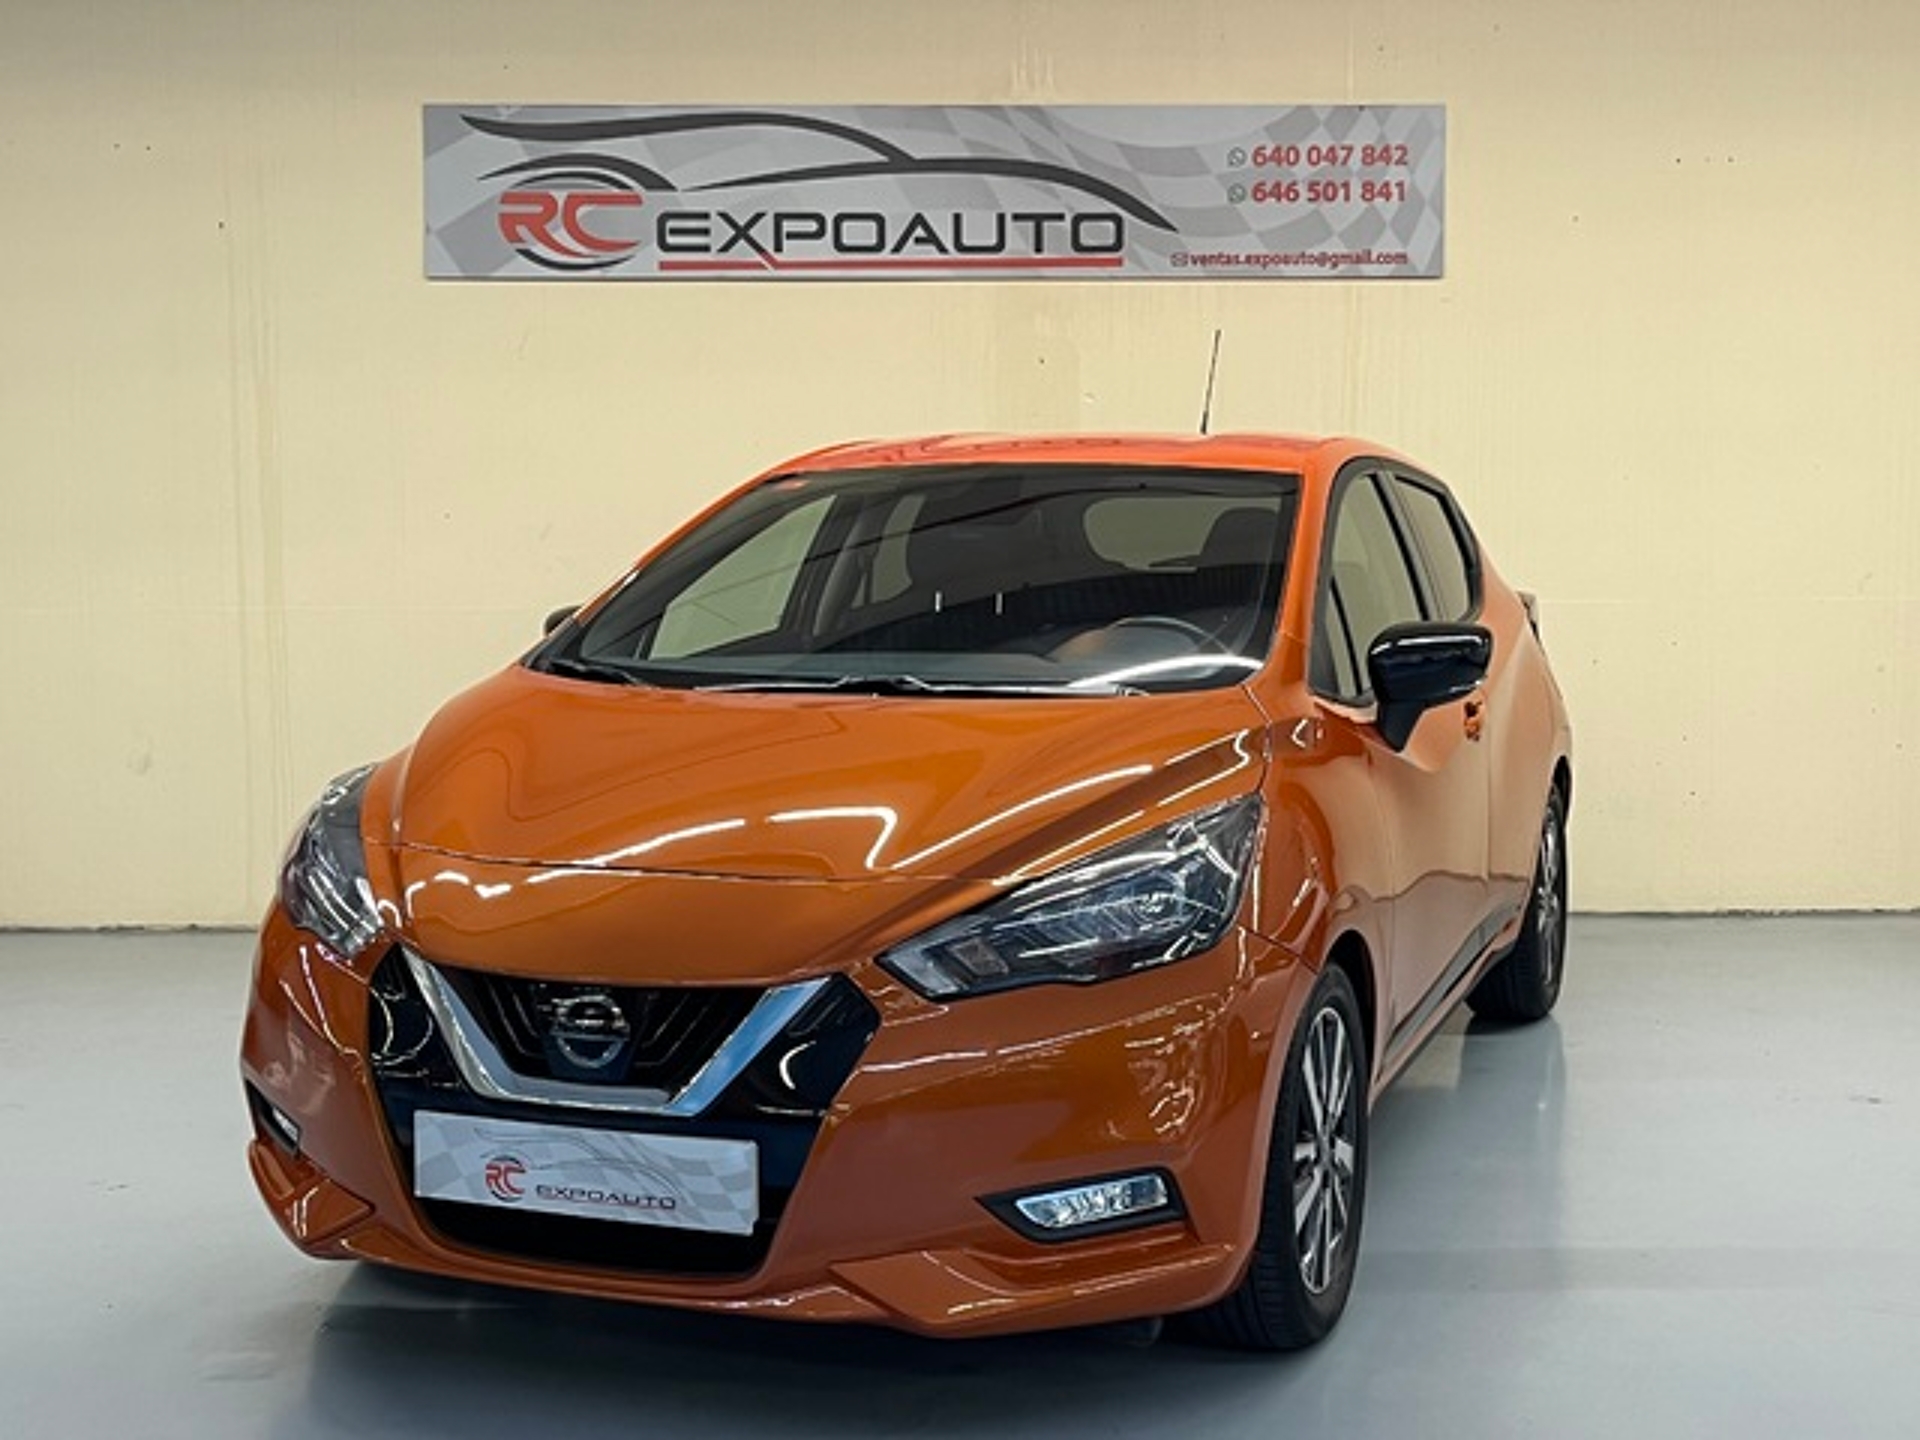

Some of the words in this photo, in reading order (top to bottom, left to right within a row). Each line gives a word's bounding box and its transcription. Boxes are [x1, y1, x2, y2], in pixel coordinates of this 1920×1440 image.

[1252, 145, 1303, 167] 640
[1306, 145, 1354, 167] 047
[1359, 145, 1409, 167] 842
[1252, 181, 1303, 203] 646
[1306, 181, 1352, 203] 501
[1359, 181, 1407, 203] 841
[496, 190, 645, 259] RC
[656, 210, 1125, 254] EXPOAUTO
[1189, 249, 1409, 269] ventas.expoauto@gmail.com
[484, 1161, 527, 1197] RC
[535, 1183, 677, 1210] EXPOAUTO
